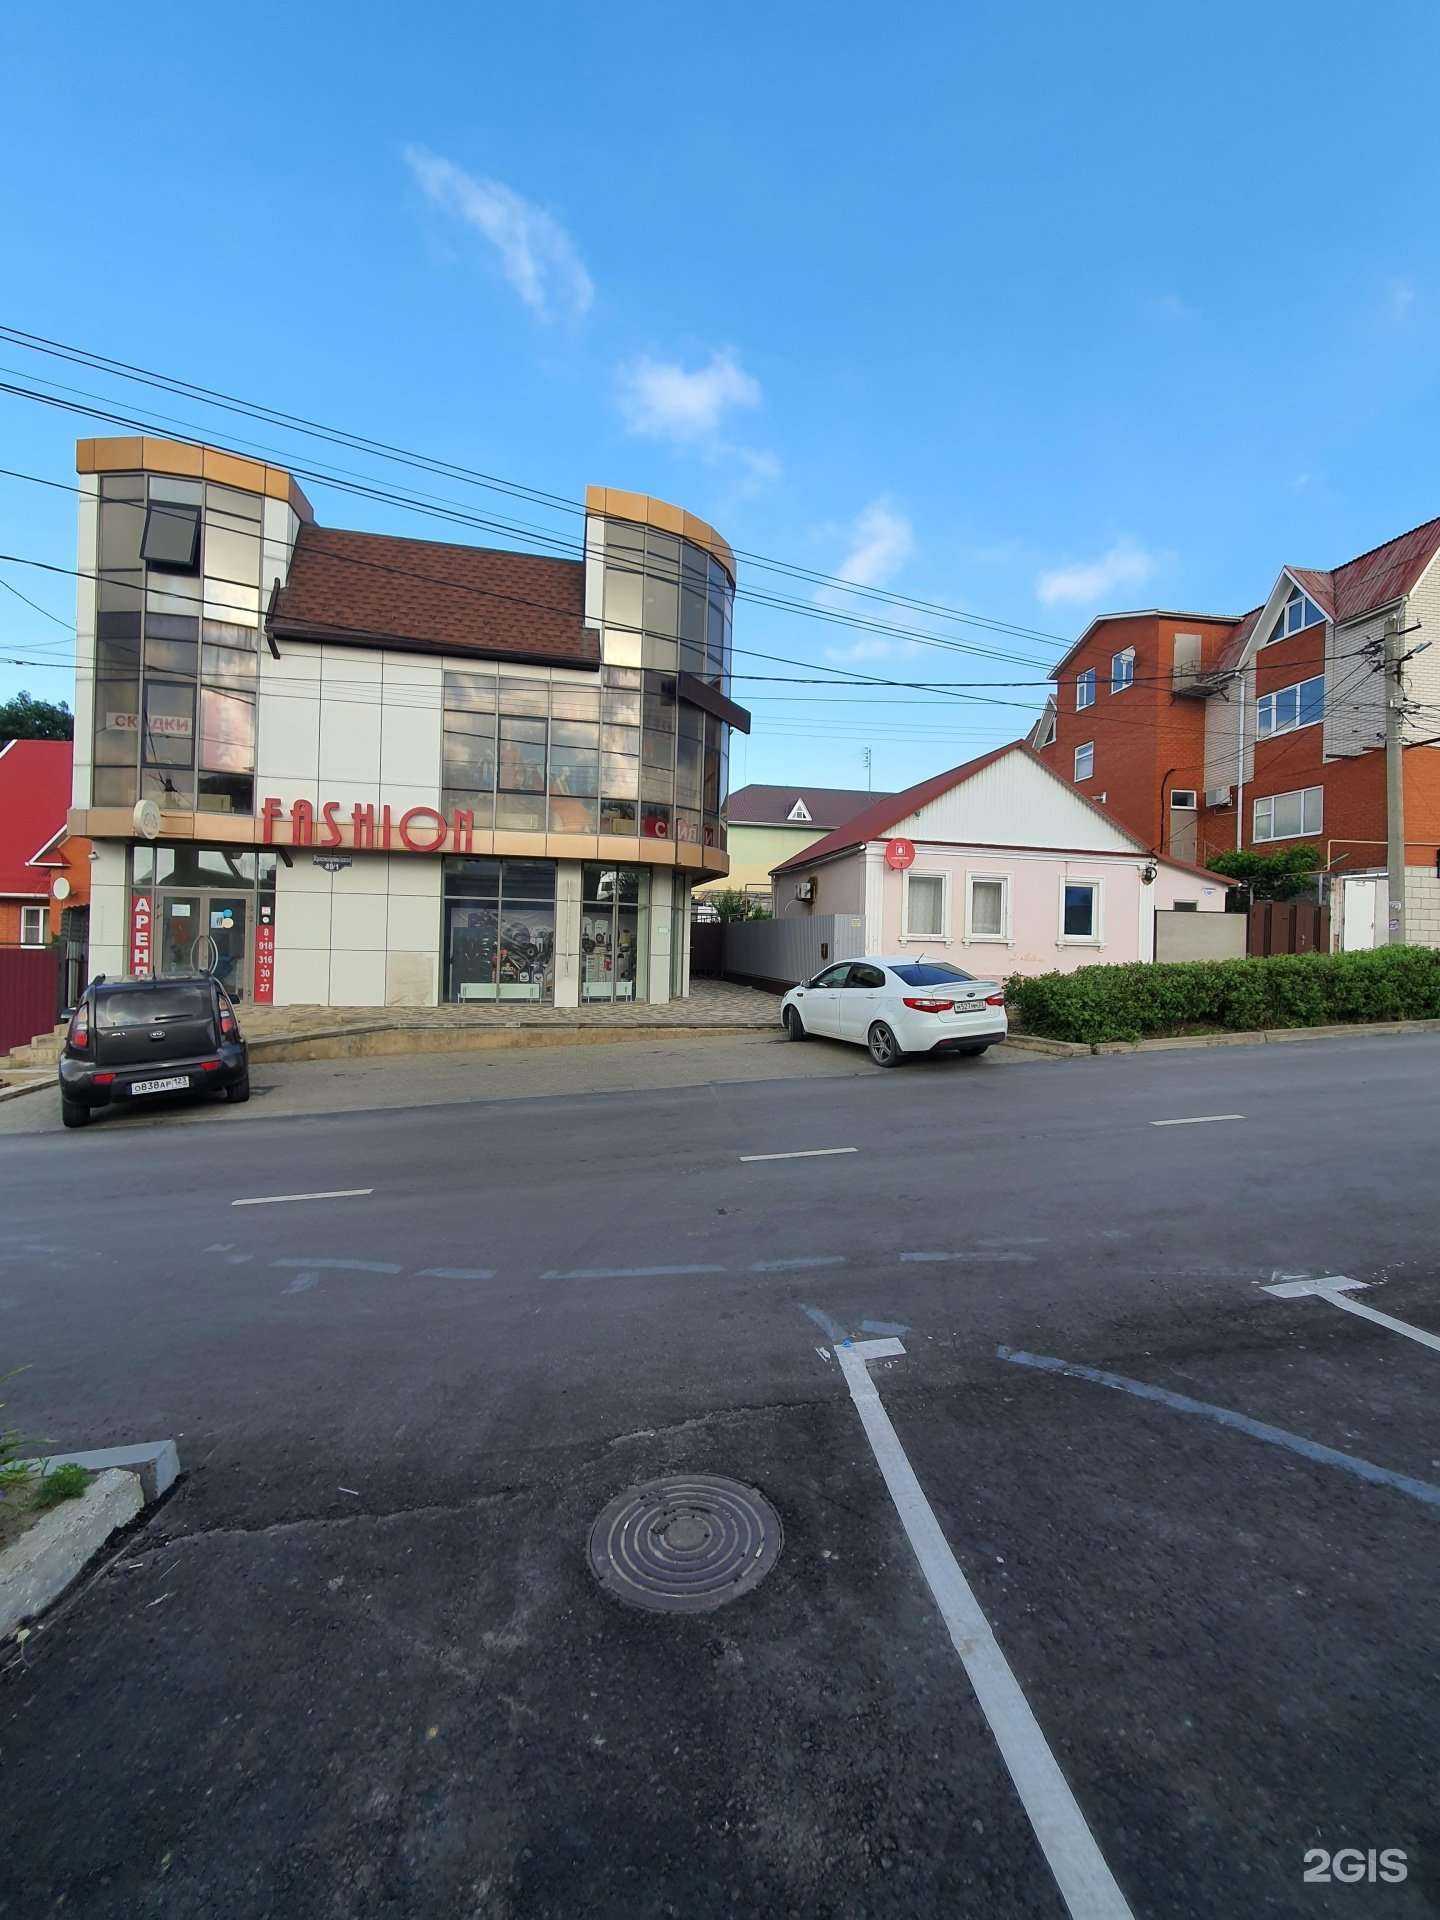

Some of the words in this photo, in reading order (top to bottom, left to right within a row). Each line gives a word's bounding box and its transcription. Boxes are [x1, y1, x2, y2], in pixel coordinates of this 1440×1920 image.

[115, 714, 189, 732] СКДКИ
[261, 798, 475, 854] FASHION
[260, 969, 271, 978] 30
[259, 983, 270, 992] 27
